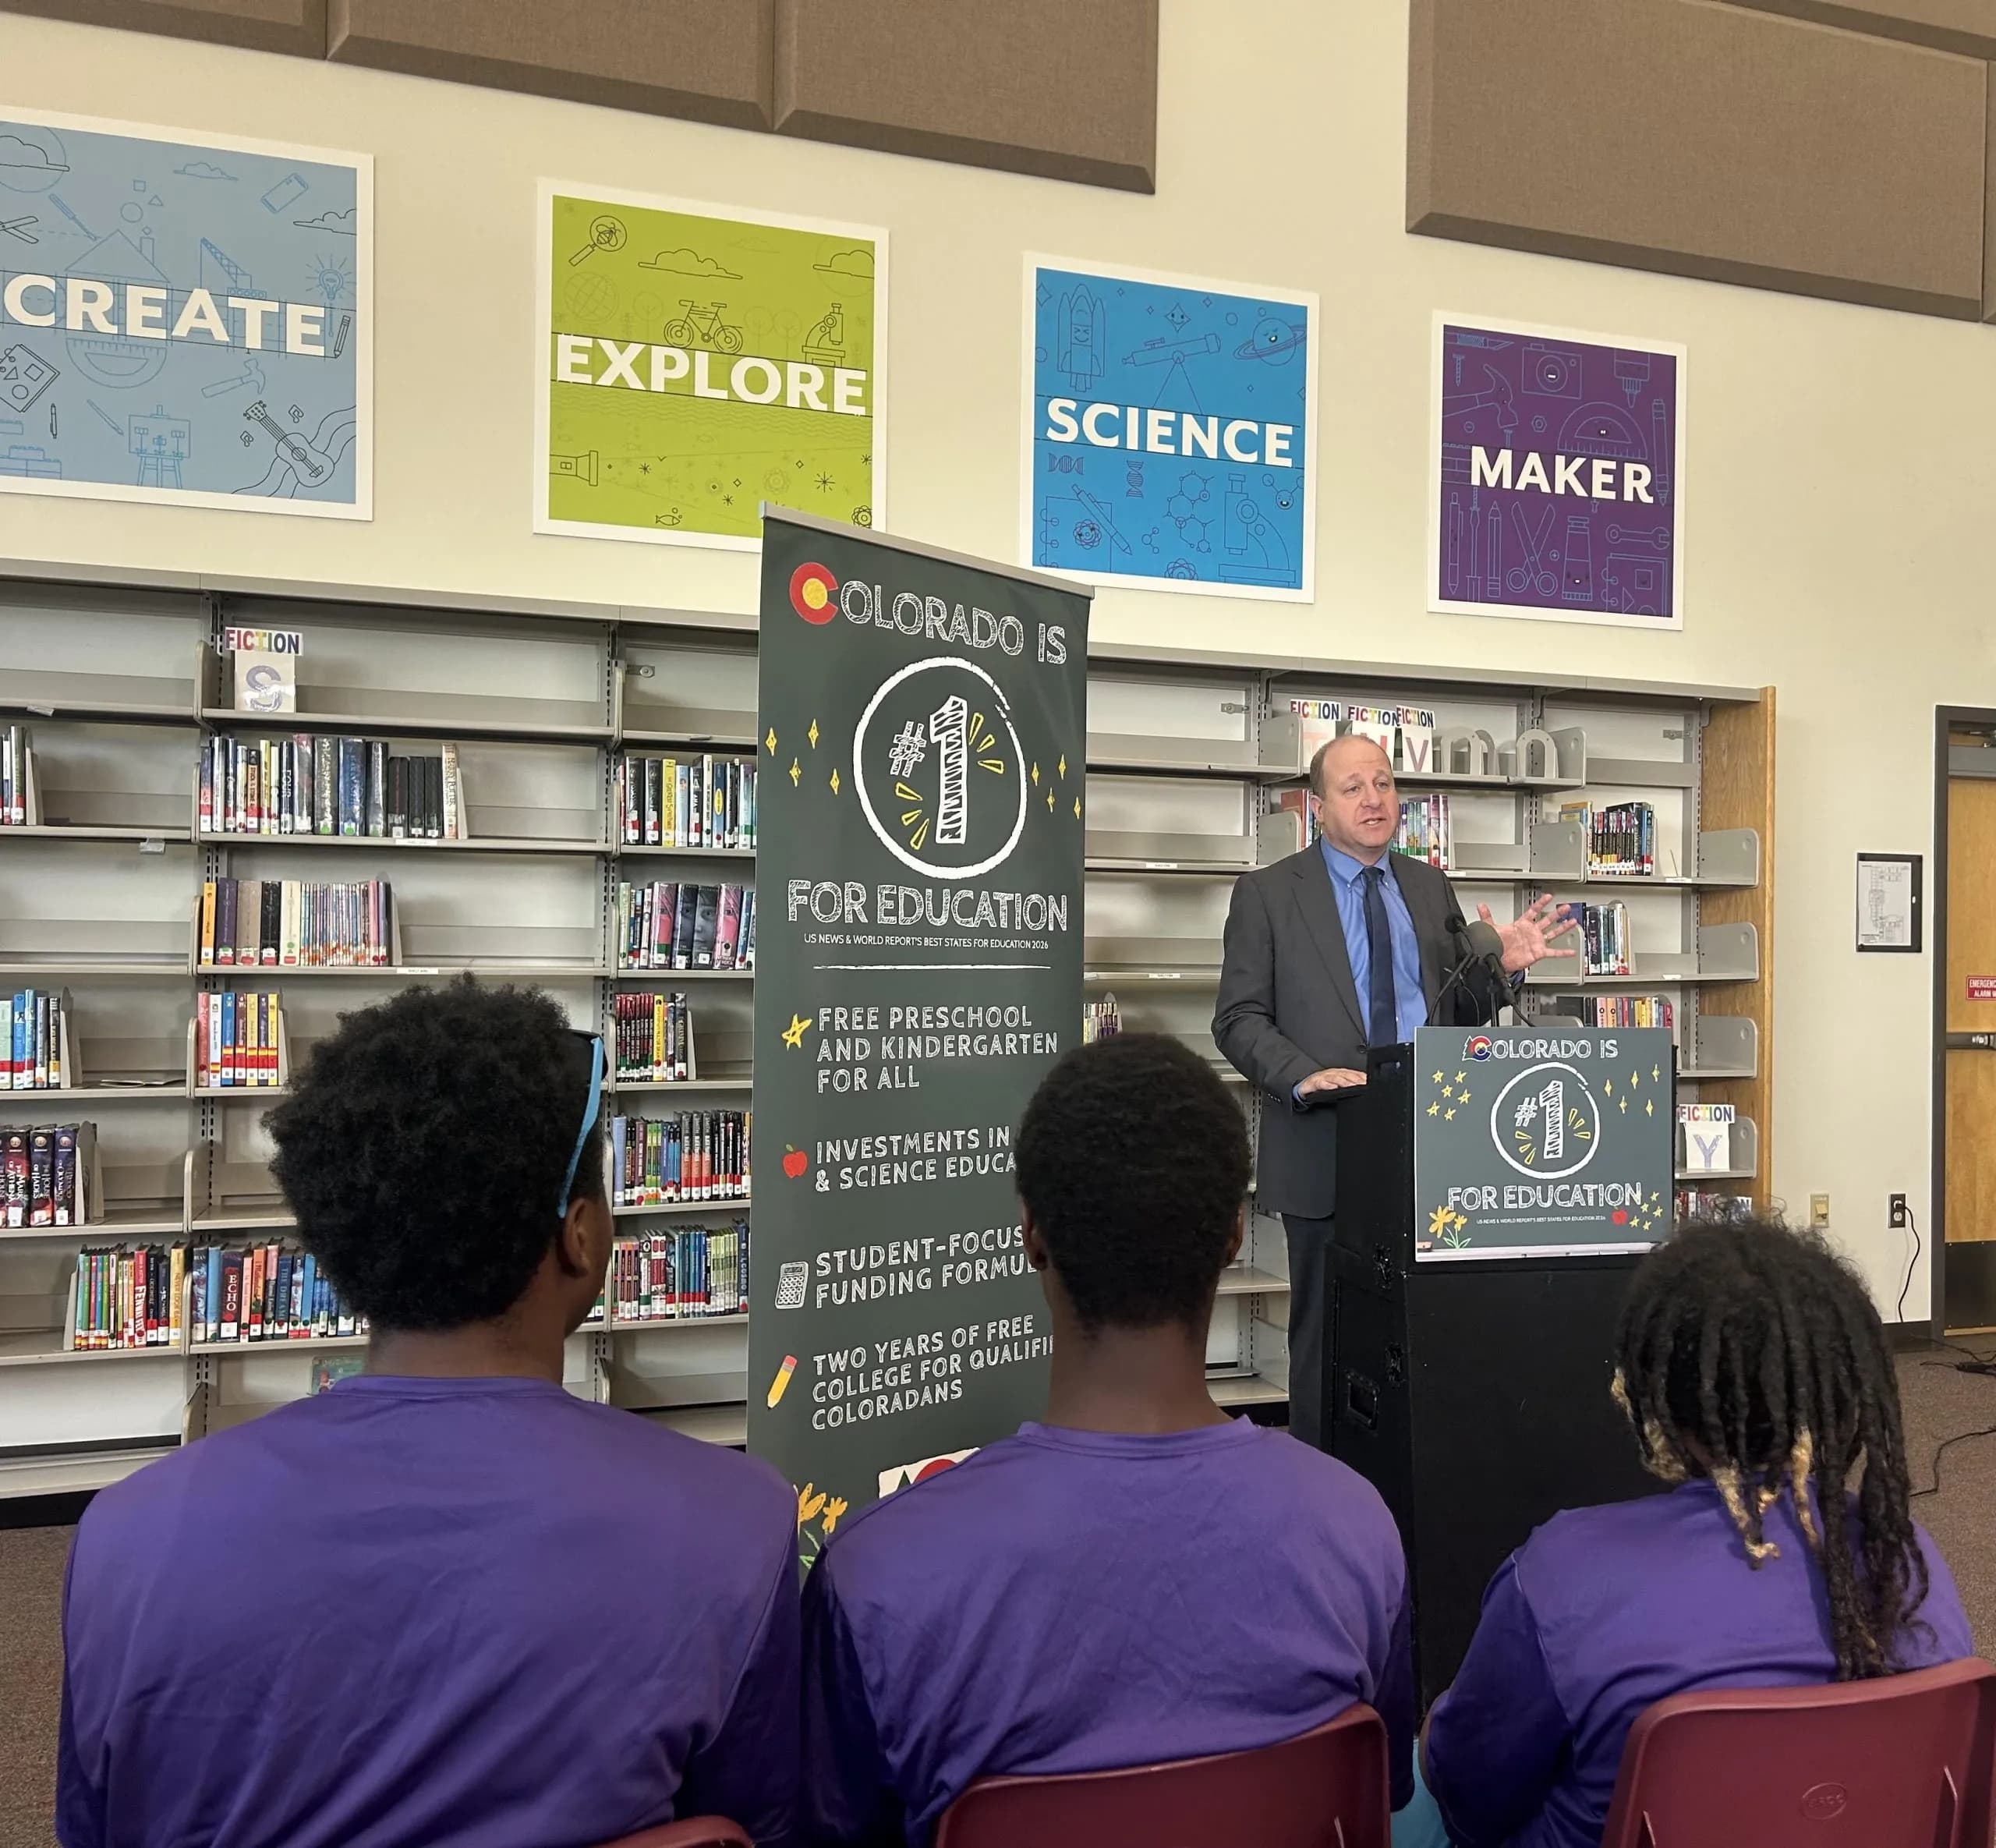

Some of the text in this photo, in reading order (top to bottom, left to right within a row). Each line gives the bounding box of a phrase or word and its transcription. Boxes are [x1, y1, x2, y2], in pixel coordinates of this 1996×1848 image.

[3, 273, 326, 356] CREATE
[556, 334, 867, 416] EXPLORE
[1046, 398, 1293, 468] SCIENCE
[1471, 445, 1654, 504] MAKER
[789, 561, 1067, 665] COLORADO IS
[225, 628, 299, 654] FICTION
[245, 665, 282, 712] S
[1290, 700, 1340, 720] FICTION
[1347, 706, 1400, 727] FICTION
[1396, 706, 1434, 728] FICTION
[888, 695, 968, 844] #1
[1405, 737, 1429, 772] V
[281, 769, 292, 798] FOUR
[448, 781, 457, 806] POTTER
[787, 880, 1067, 931] FOR EDUCATION
[804, 933, 1049, 950] US NEWS & WORLD REPORT'S BEST STATES FOR EDUCATION 2026
[1974, 989, 1991, 998] ALARM
[819, 1005, 1032, 1032] FREE PRESCHOOL
[816, 1032, 1058, 1062] AND KINDERGARTEN
[1467, 1036, 1619, 1061] COLORADO IS
[818, 1065, 920, 1093] FOR ALL
[1514, 1080, 1563, 1159] #1
[1679, 1106, 1732, 1122] FICTION
[816, 1126, 1010, 1164] INVESTMENTS IN
[1693, 1135, 1723, 1168] Y
[6, 1170, 16, 1202] ATHENA
[31, 1172, 41, 1199] HADES
[41, 1174, 51, 1198] HOUSE
[816, 1170, 830, 1191] &
[840, 1159, 937, 1190] SCIENCE
[1448, 1182, 1642, 1211] FOR EDUCATION
[816, 1225, 1024, 1277] STUDENT-FOCUS
[226, 1274, 238, 1311] ECHO
[816, 1267, 932, 1308] FUNDING
[813, 1315, 1034, 1375] TWO YEARS OF FREE
[812, 1364, 912, 1403] COLLEGE
[920, 1354, 961, 1381] FOR
[812, 1379, 963, 1431] COLORADANS
